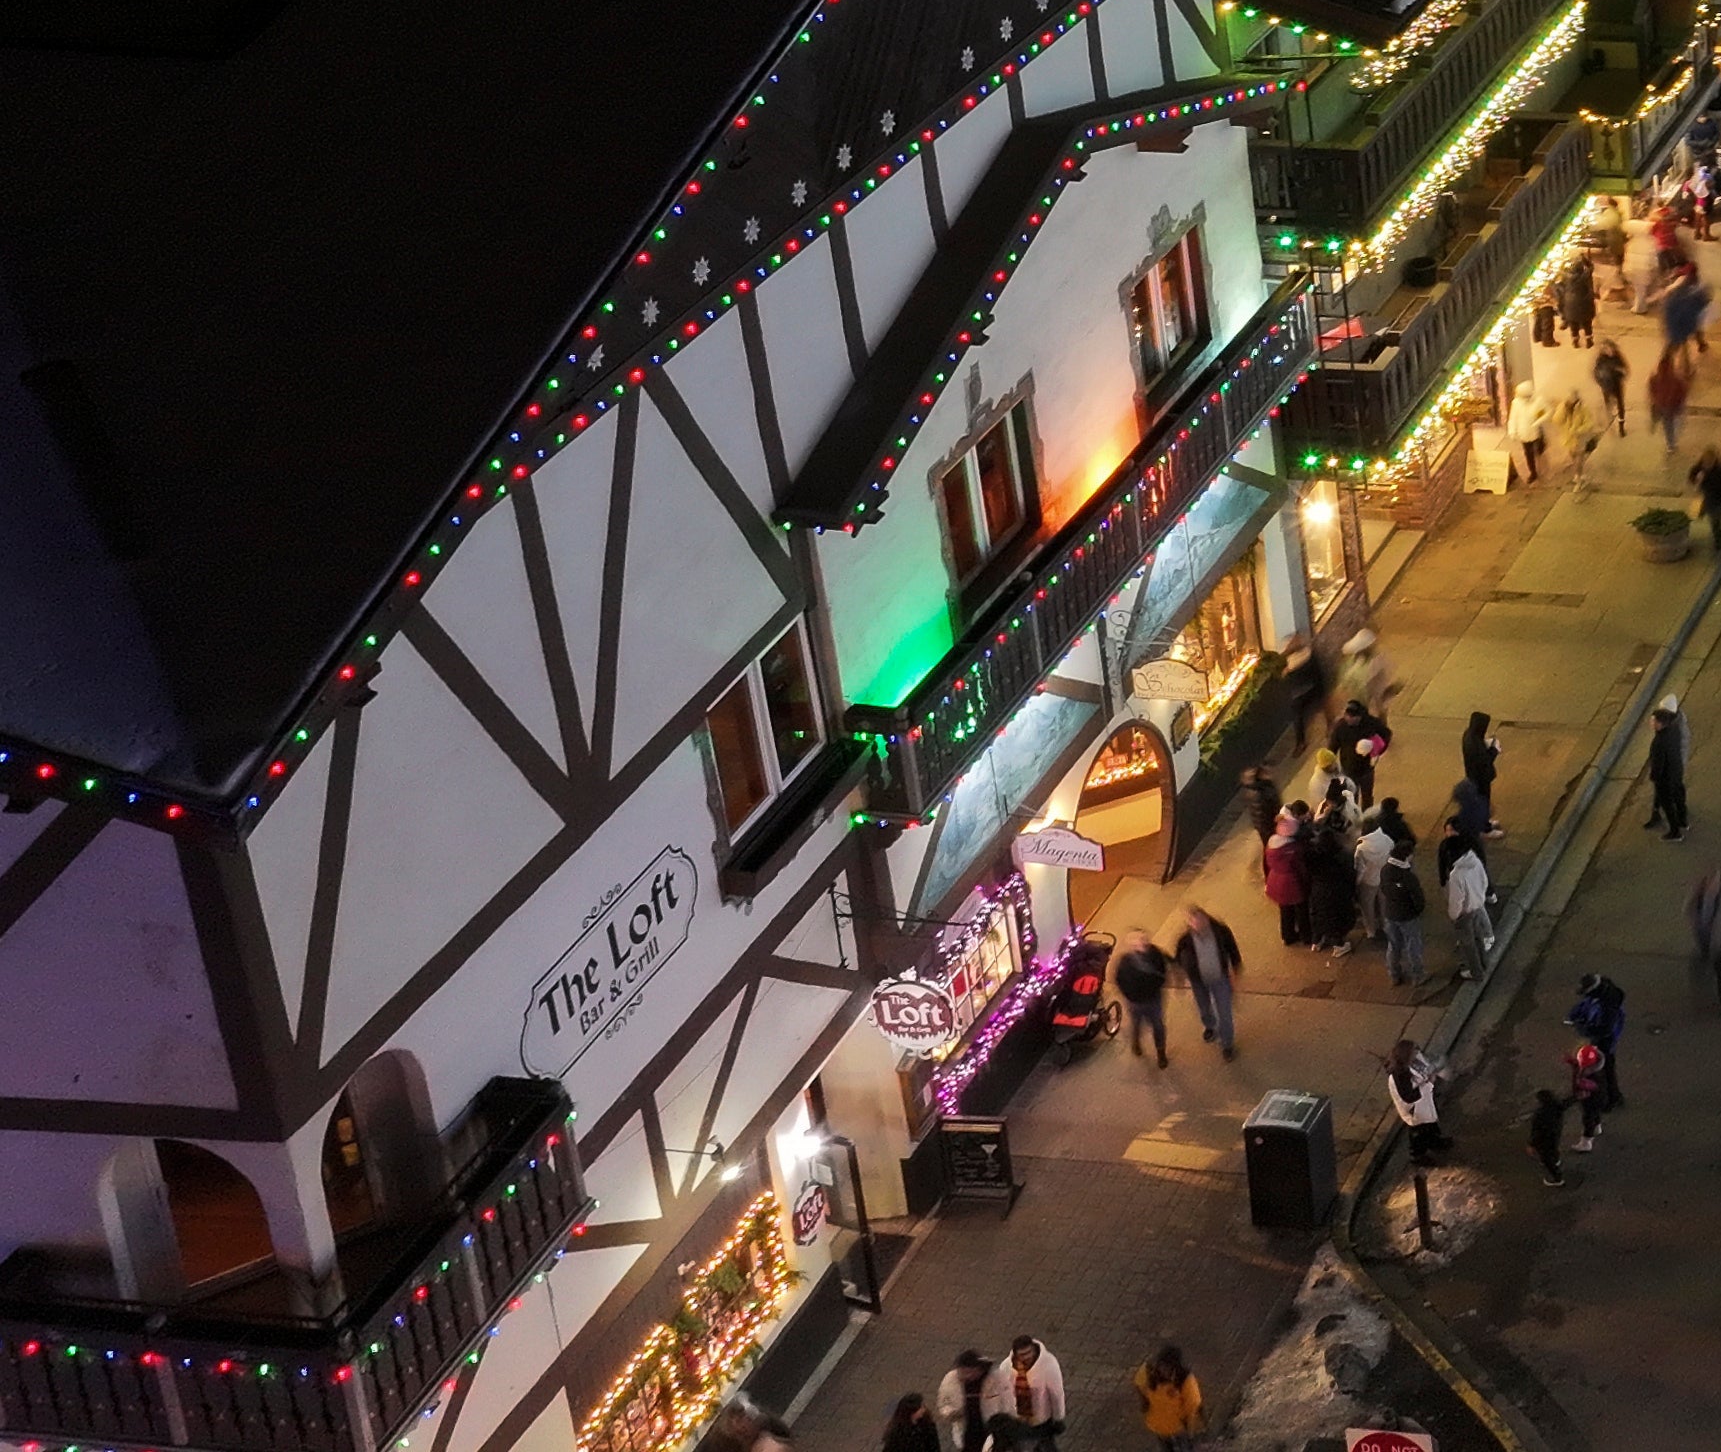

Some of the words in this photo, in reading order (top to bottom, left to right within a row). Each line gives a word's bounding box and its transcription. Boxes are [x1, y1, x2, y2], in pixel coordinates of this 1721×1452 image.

[1023, 837, 1099, 864] Magenta
[539, 957, 601, 1036] The
[606, 868, 680, 969] Loft
[580, 997, 605, 1036] Bar
[609, 979, 622, 1002] &
[625, 936, 660, 983] Grill
[889, 994, 911, 1005] The
[881, 1000, 946, 1026] Loft
[1361, 1443, 1381, 1452] DO
